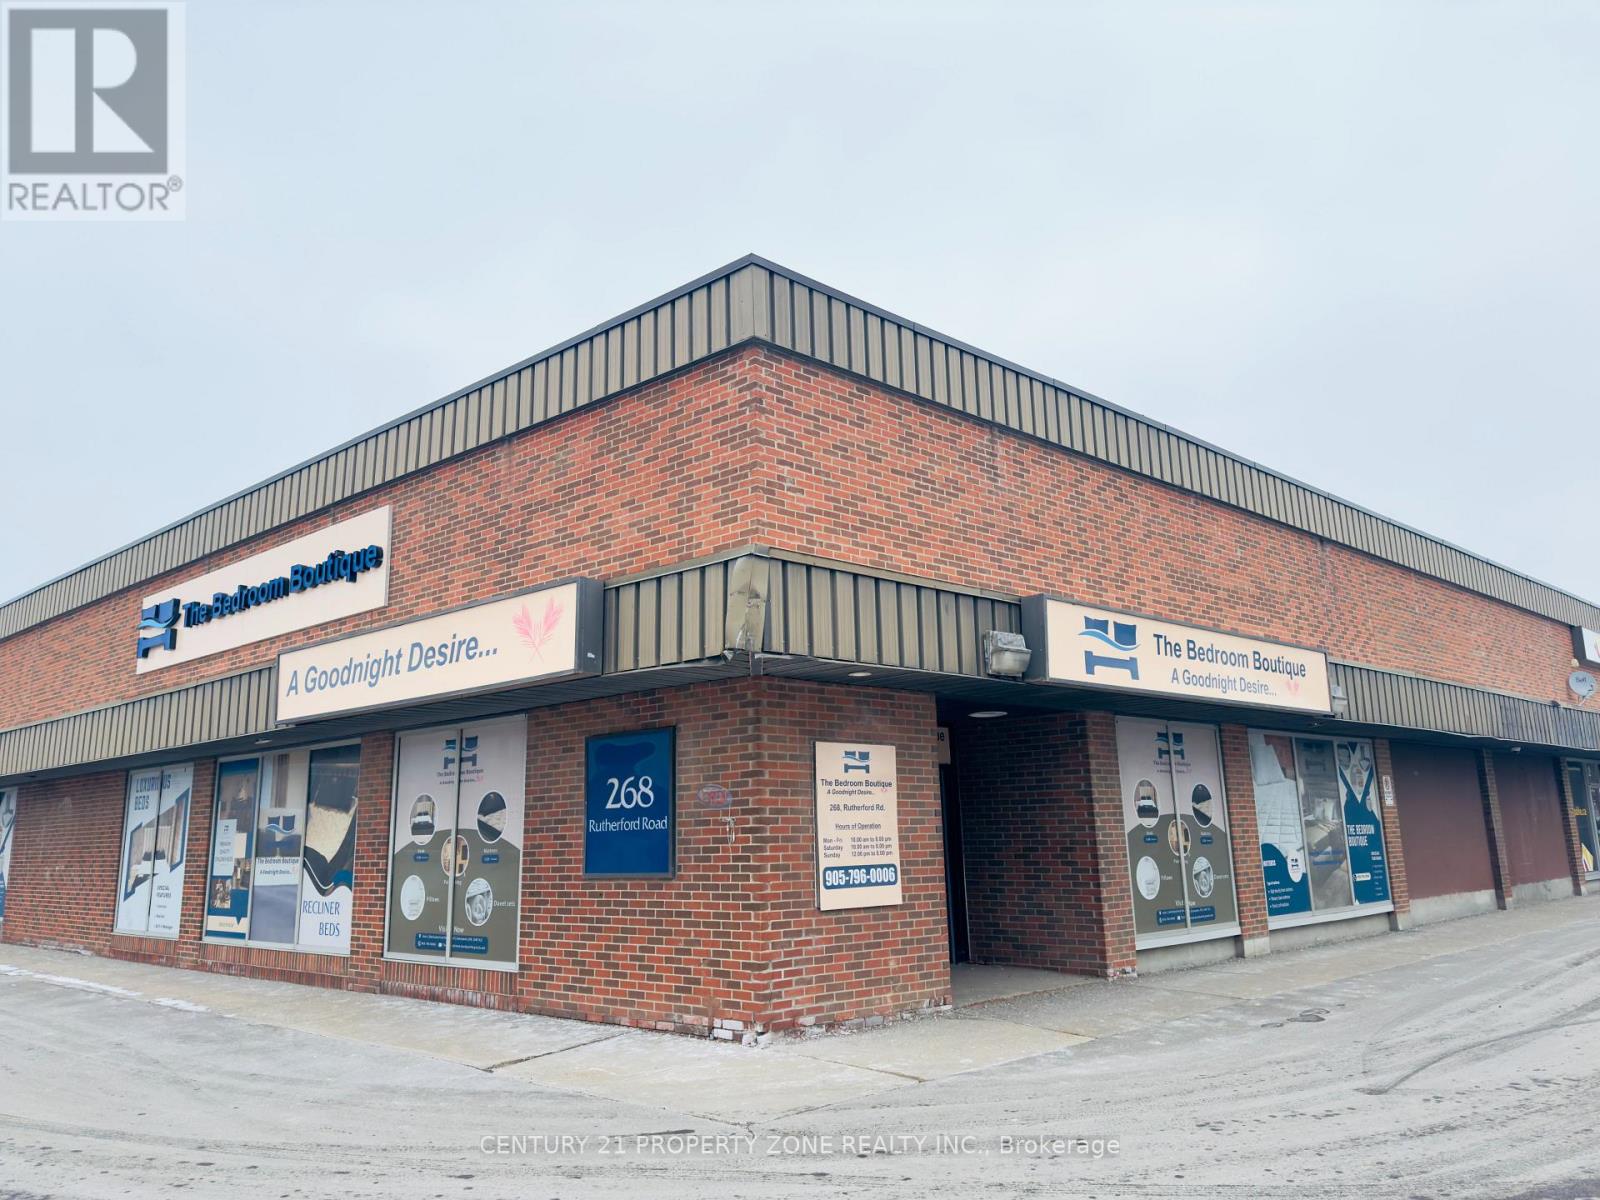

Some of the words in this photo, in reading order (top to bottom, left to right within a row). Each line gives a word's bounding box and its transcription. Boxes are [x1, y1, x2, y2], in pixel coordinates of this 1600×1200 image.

[182, 601, 212, 628] The
[211, 576, 289, 619] Bedroom
[289, 544, 383, 593] Boutique
[286, 670, 298, 697] A
[304, 647, 402, 687] Goodnight
[407, 633, 497, 672] Desire...
[1153, 633, 1182, 658] The
[1186, 639, 1249, 669] Bedroom
[1253, 650, 1306, 680] Boutique
[1171, 667, 1180, 684] A
[1182, 669, 1237, 694] Goodnight
[605, 776, 654, 809] 268
[820, 778, 834, 787] The
[834, 779, 864, 787] Bedroom
[864, 779, 892, 789] Boutique
[843, 803, 875, 812] Rutherford
[875, 803, 886, 811] Rd.
[589, 816, 640, 832] Rutherford
[642, 816, 667, 830] Road
[835, 823, 851, 831] Hours
[857, 823, 882, 831] Operation
[825, 866, 896, 886] 905-796-0006
[302, 900, 340, 915] RECLINER
[318, 922, 340, 937] BEDS
